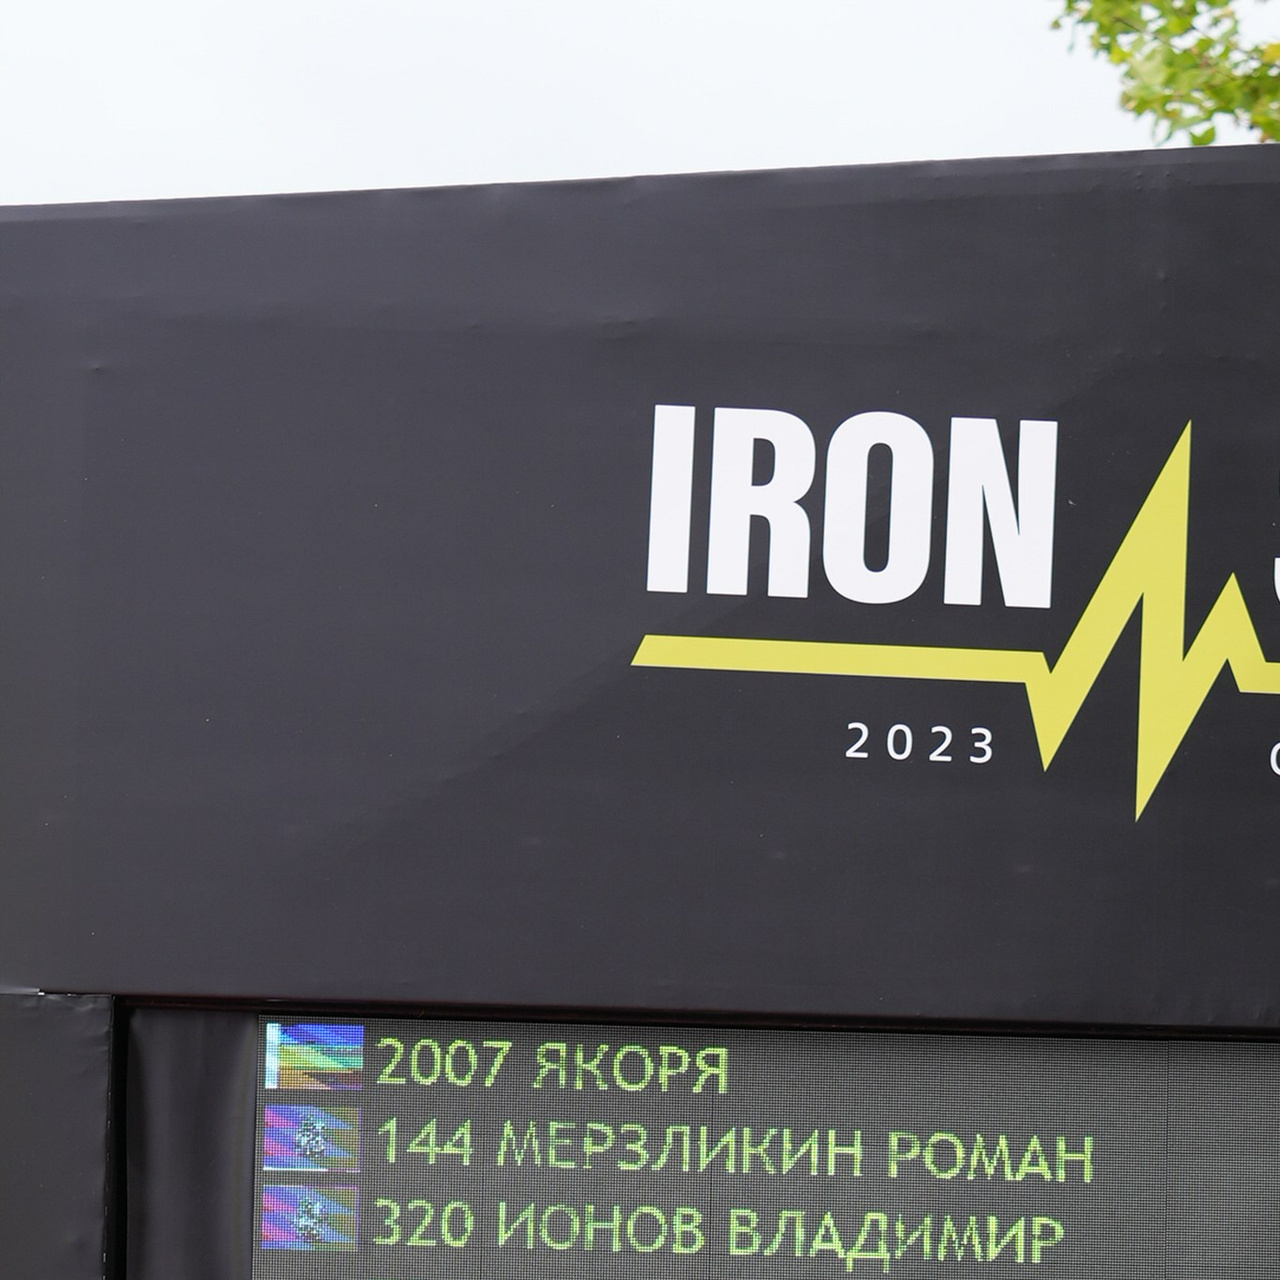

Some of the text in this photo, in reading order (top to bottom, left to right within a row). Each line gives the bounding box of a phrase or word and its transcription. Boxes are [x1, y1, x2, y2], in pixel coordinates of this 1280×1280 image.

[646, 404, 1058, 609] IRON
[845, 721, 994, 765] 2023
[377, 1037, 729, 1094] 2007 ЯКОРЯ
[377, 1117, 1095, 1183] 144 МЕРЗЛИКИН РОМАН
[373, 1197, 1065, 1272] 320 ИОНОВ ВЛАДИМИР
